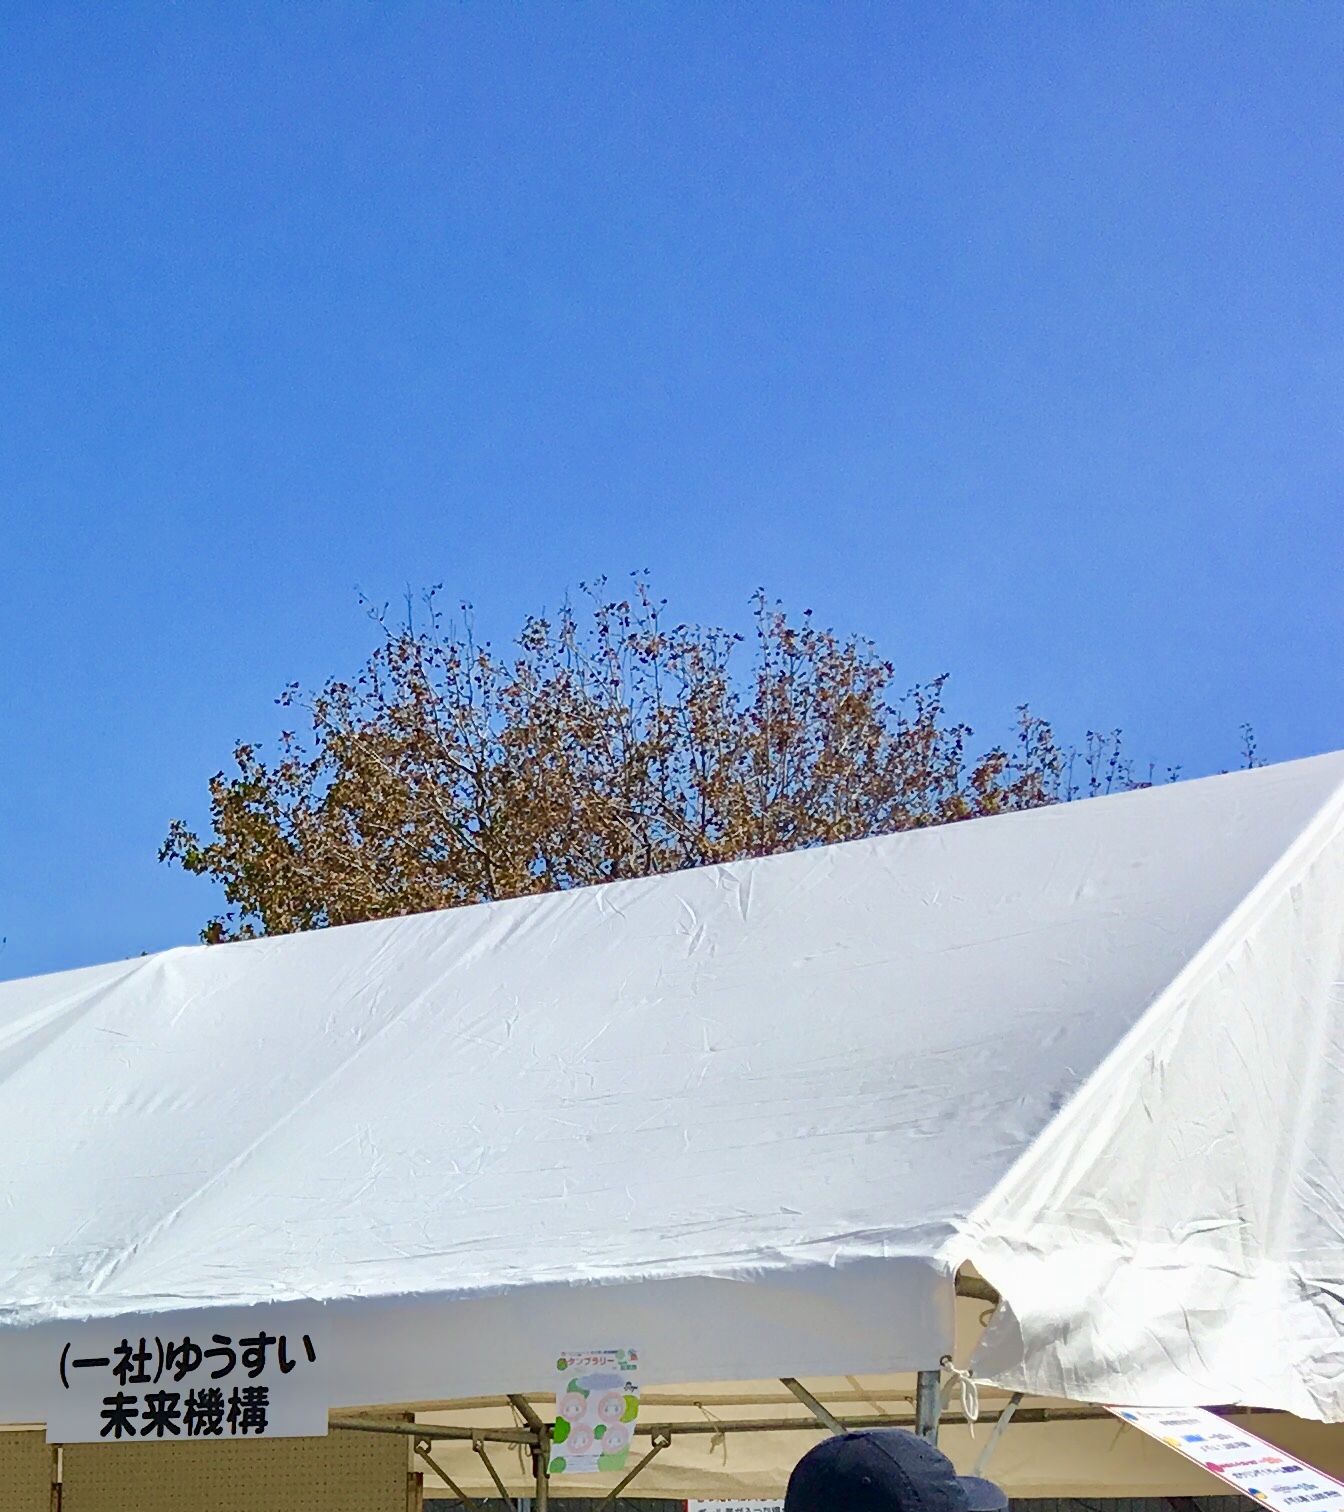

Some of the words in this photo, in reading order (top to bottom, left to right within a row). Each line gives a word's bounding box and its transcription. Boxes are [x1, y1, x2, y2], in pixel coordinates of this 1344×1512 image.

[60, 1332, 316, 1388] (一社)ゆうすい
[100, 1386, 269, 1438] 未来機構
